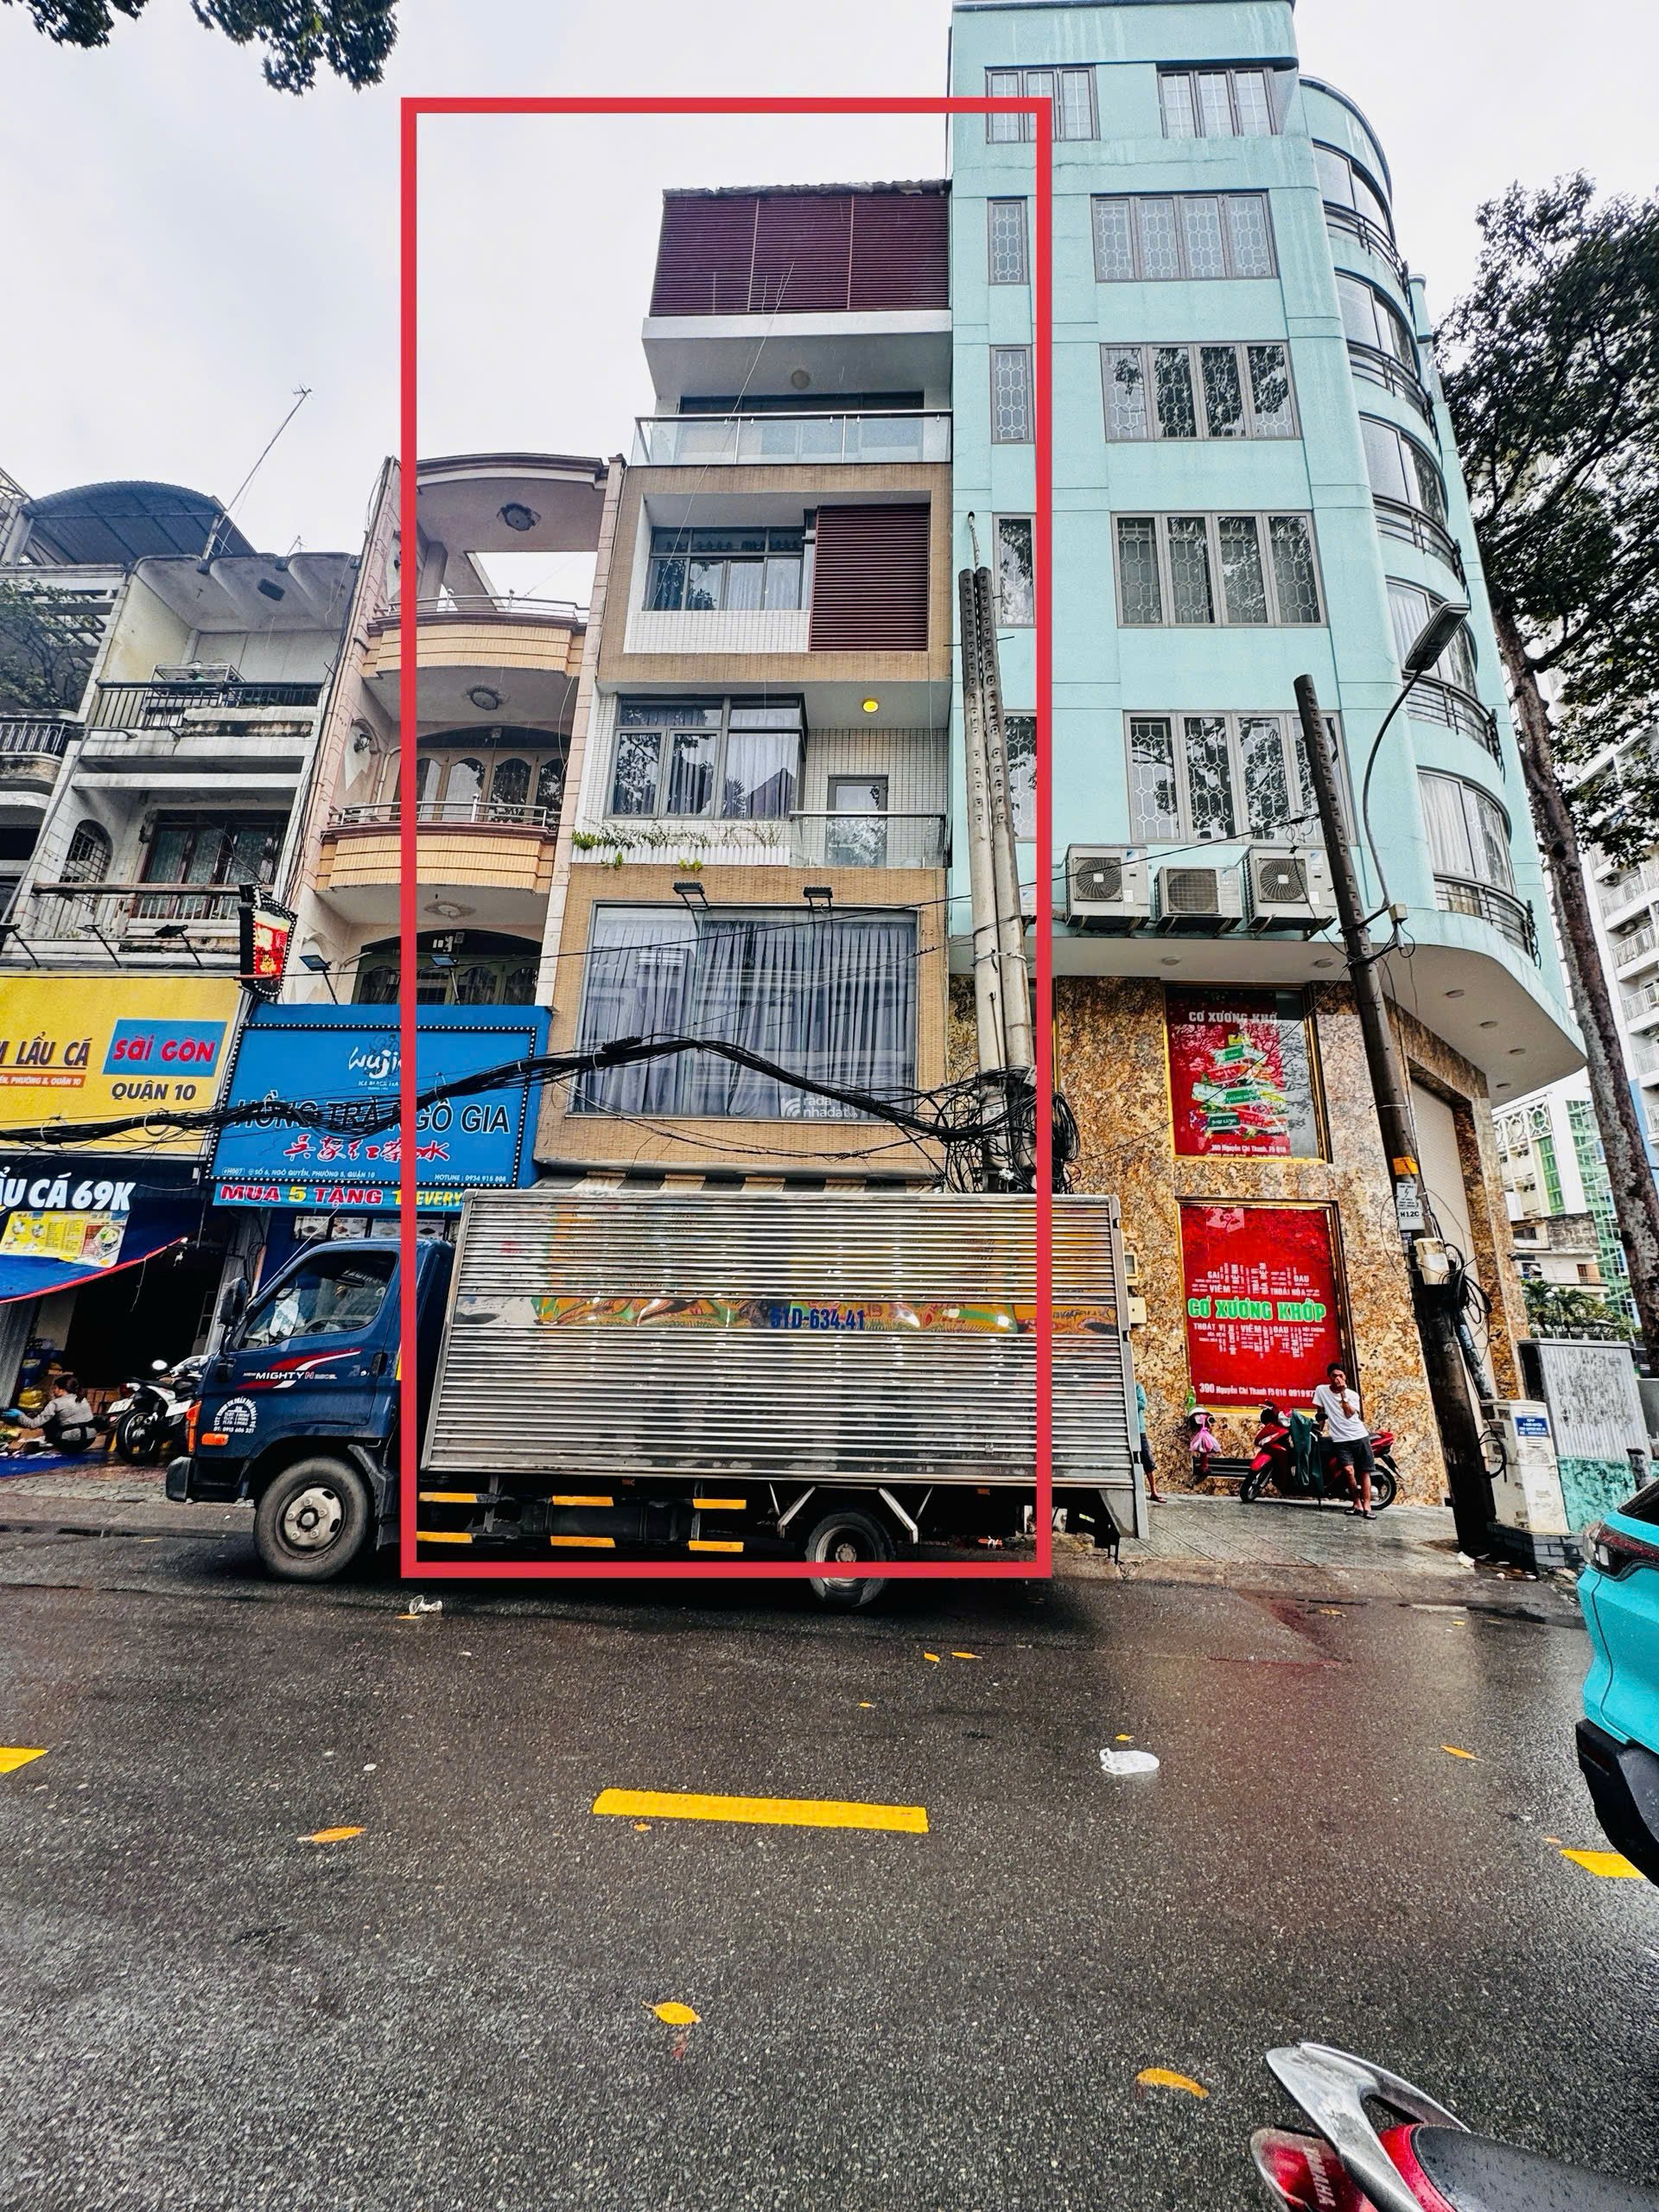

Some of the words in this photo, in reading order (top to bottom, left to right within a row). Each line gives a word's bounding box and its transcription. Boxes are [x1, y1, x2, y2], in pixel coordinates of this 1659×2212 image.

[1188, 1010, 1205, 1022] CƠ
[1208, 1010, 1248, 1024] XƯƠNG
[1251, 1011, 1279, 1026] KHỚ
[16, 1031, 57, 1065] LẨU
[64, 1037, 93, 1066] CÁ
[161, 1037, 216, 1062] GÒN
[73, 1077, 82, 1086] 10
[111, 1080, 169, 1103] QUẬN
[175, 1084, 197, 1101] 10
[460, 1104, 512, 1135] GIA
[28, 1172, 73, 1209] CÁ
[71, 1180, 137, 1211] 69K
[220, 1185, 281, 1202] MUA
[289, 1185, 308, 1203] 5
[314, 1185, 383, 1208] TẶNG
[416, 1190, 467, 1207] EVERY
[1187, 1295, 1212, 1319] CƠ
[1214, 1296, 1274, 1321] XƯƠNG
[1277, 1298, 1327, 1323] KHỚP
[256, 1371, 305, 1381] MIGHTY
[1199, 1382, 1215, 1394] 390
